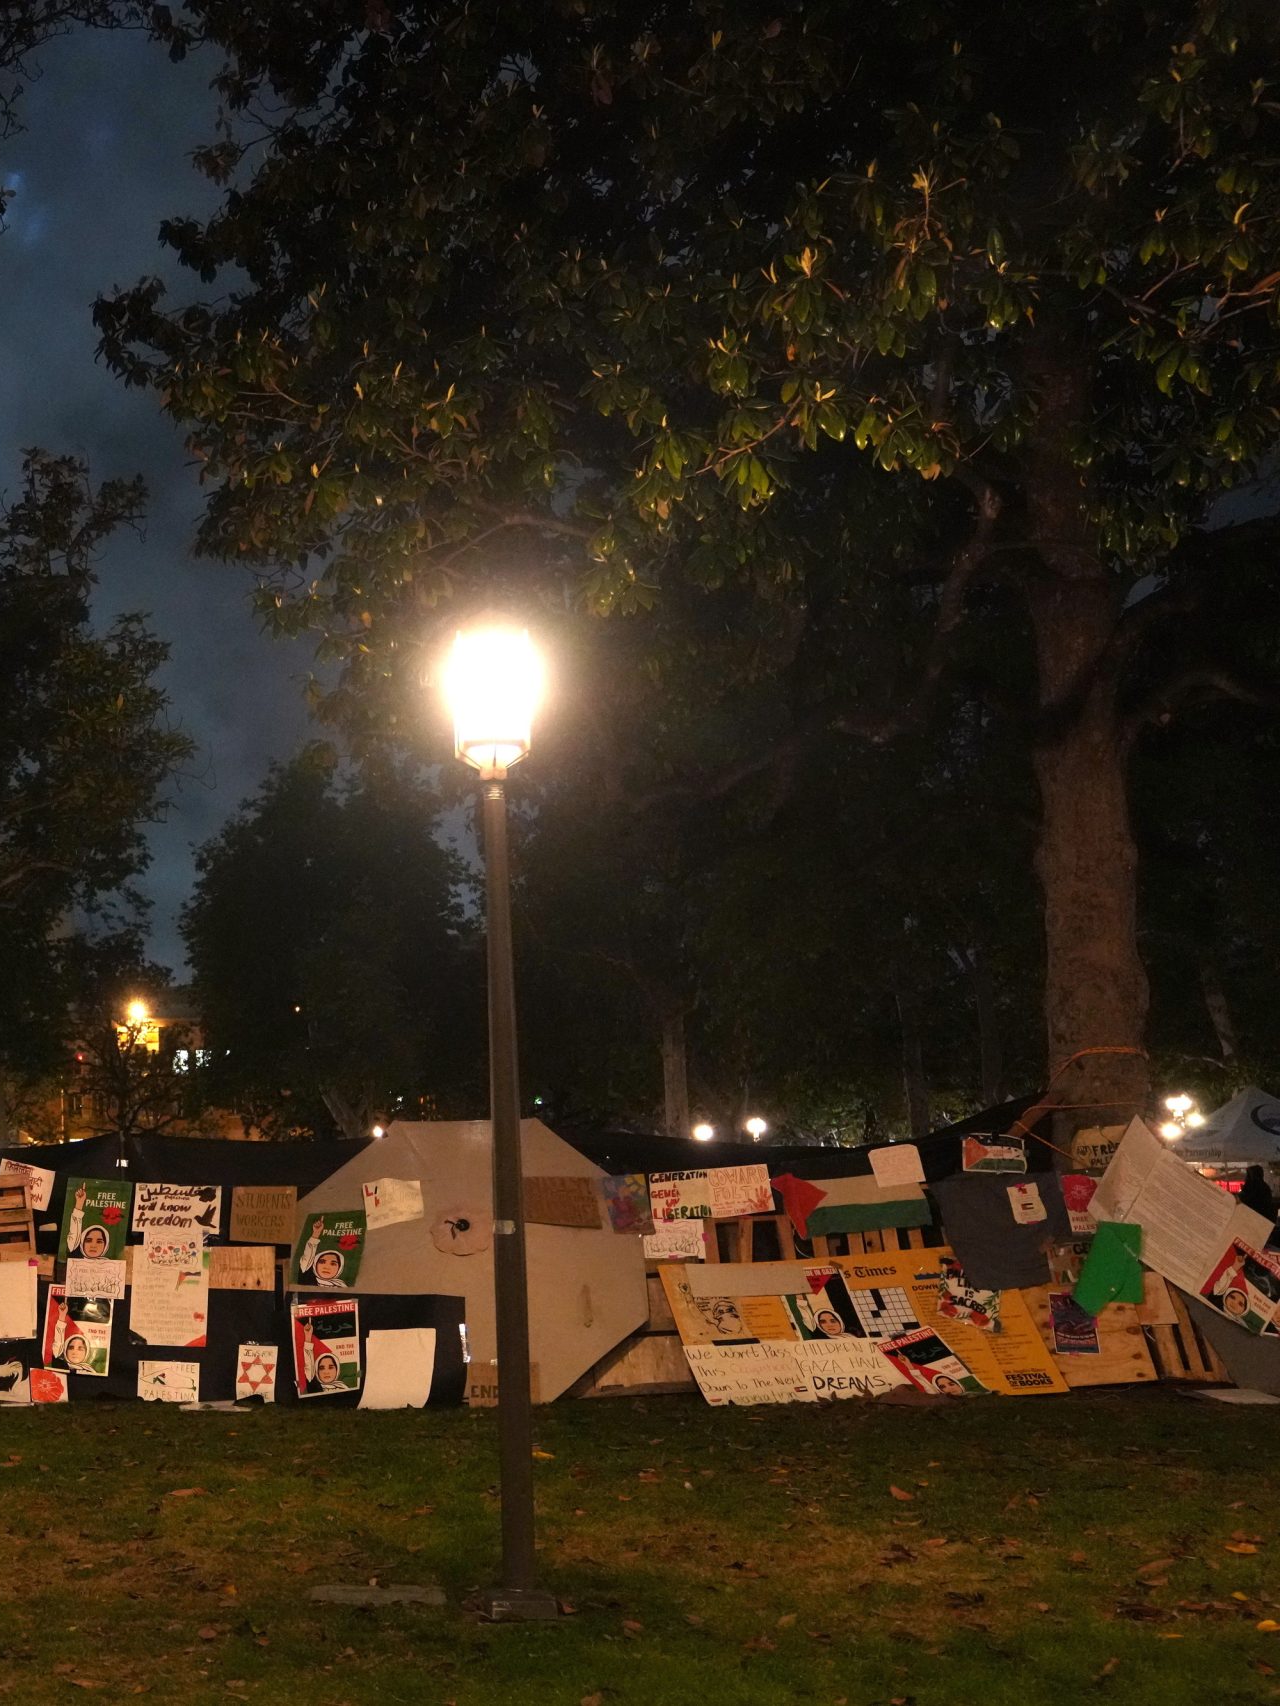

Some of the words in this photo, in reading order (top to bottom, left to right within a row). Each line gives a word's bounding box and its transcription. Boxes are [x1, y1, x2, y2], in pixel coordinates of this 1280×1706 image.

[650, 1171, 708, 1183] GENERATION
[710, 1167, 768, 1187] COWARD
[97, 1192, 116, 1200] FREE
[236, 1193, 292, 1210] STUDENTS
[85, 1199, 126, 1209] PALESTINE
[137, 1201, 158, 1212] will
[159, 1202, 192, 1213] know
[134, 1211, 194, 1229] freedom
[238, 1214, 285, 1227] WORKERS
[335, 1221, 354, 1229] FREE
[322, 1228, 363, 1237] PALESTINE
[855, 1266, 897, 1278] Times
[964, 1289, 974, 1298] IS
[315, 1303, 355, 1315] PALESTINE
[949, 1294, 987, 1314] SACRED
[880, 1341, 898, 1352] FREE
[898, 1328, 935, 1347] PALESTINE
[686, 1350, 712, 1361] We
[761, 1345, 790, 1361] Pass
[794, 1342, 864, 1357] CHILDREN
[800, 1359, 841, 1373] GAZA
[850, 1357, 887, 1369] HAVE
[698, 1366, 726, 1377] This
[1005, 1373, 1051, 1381] FESTIVAL
[699, 1382, 732, 1393] Down
[1019, 1379, 1054, 1387] BOOKS
